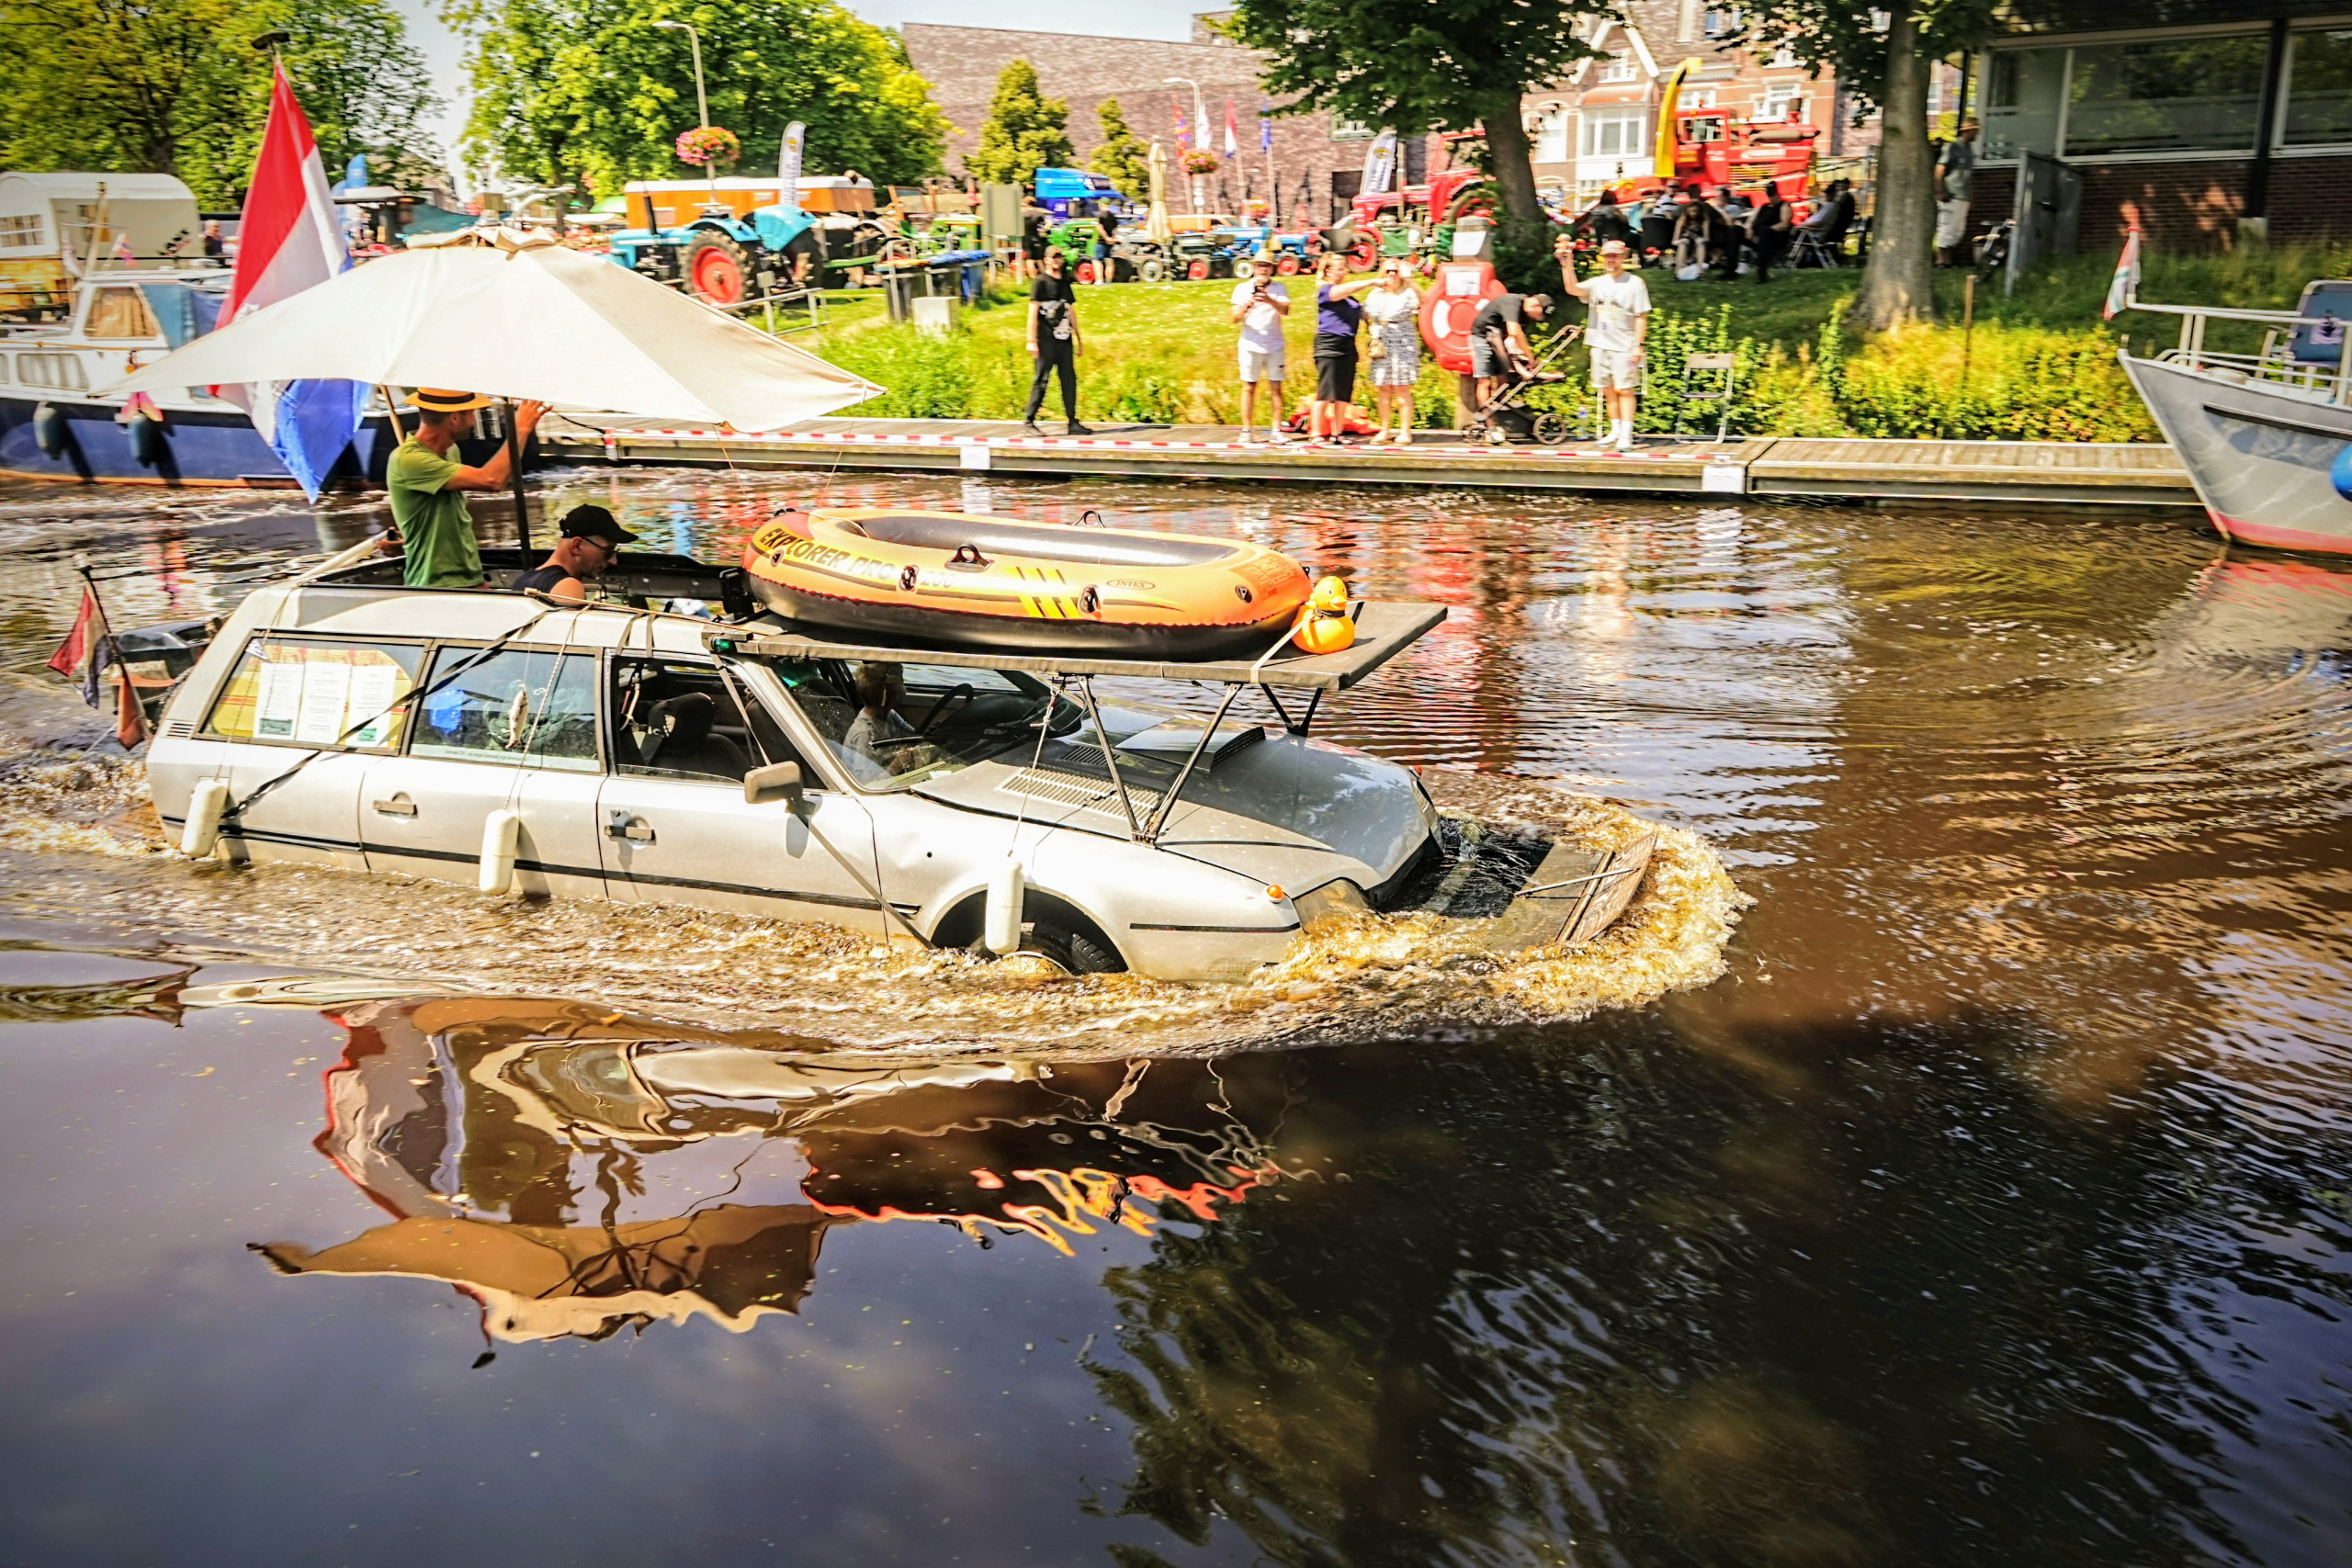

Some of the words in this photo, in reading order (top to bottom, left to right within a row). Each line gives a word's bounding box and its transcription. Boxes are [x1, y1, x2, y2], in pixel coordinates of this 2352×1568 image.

[759, 527, 851, 569] EXPLORER
[848, 557, 896, 581] PRO
[920, 570, 957, 589] 200
[1116, 581, 1146, 589] INTEX
